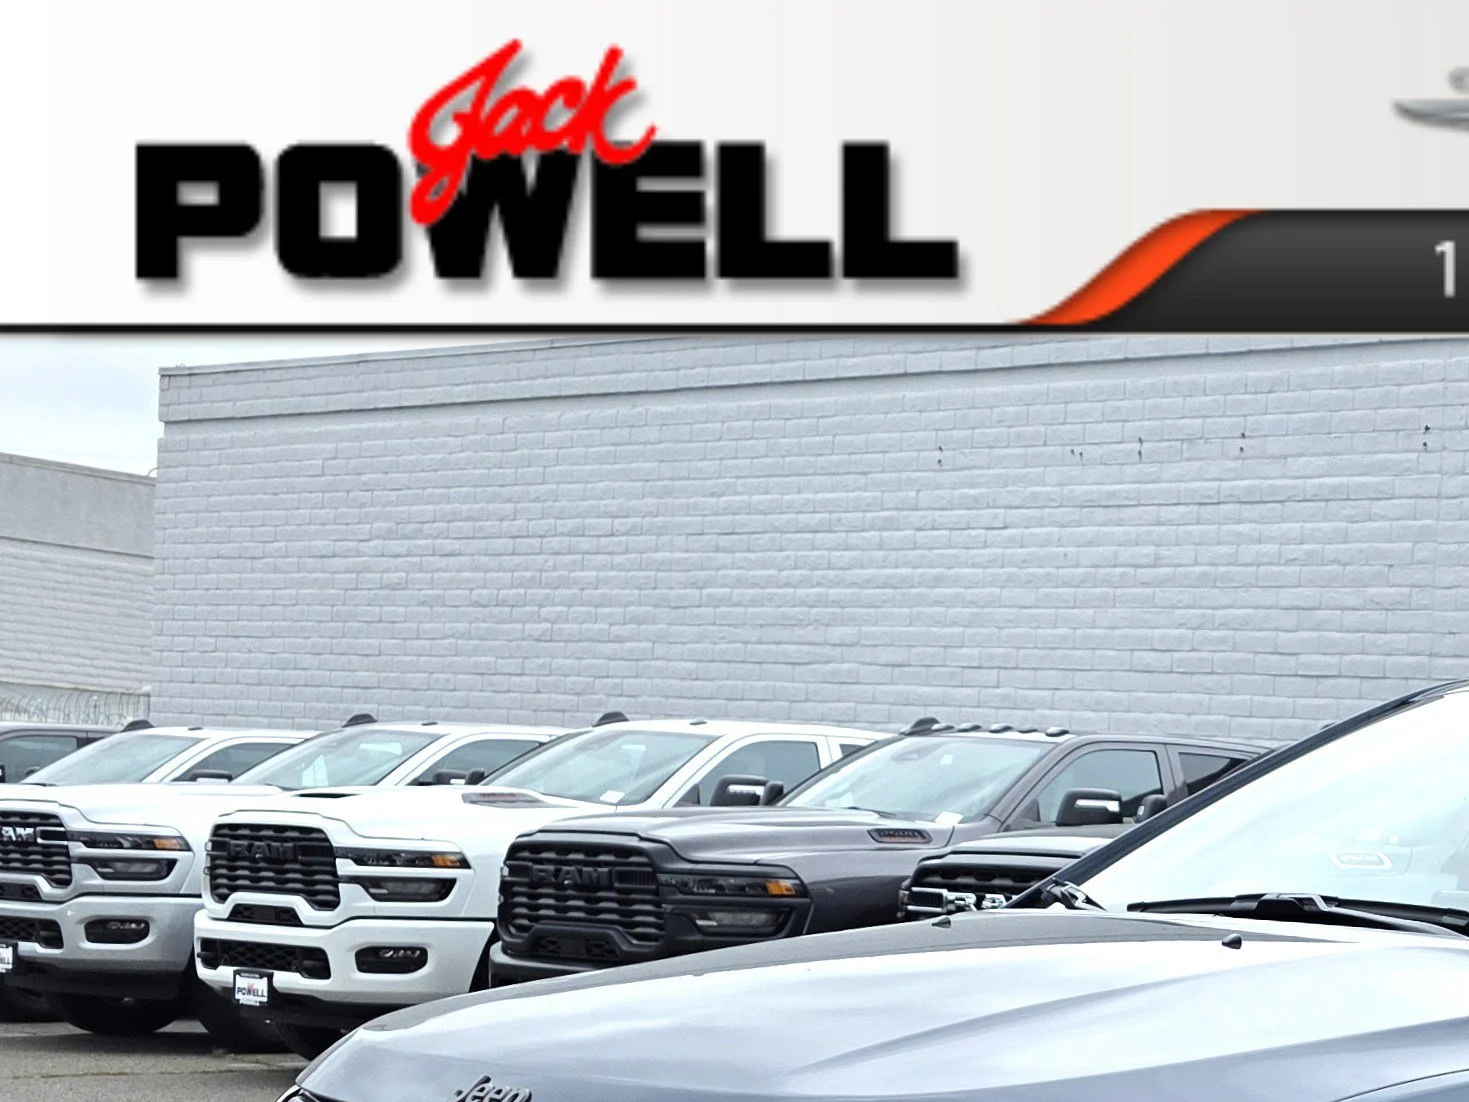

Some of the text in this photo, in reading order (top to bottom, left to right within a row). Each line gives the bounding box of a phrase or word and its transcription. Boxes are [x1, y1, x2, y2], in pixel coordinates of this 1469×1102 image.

[0, 826, 35, 842] AM
[229, 840, 296, 860] RAM
[531, 864, 613, 887] RAM
